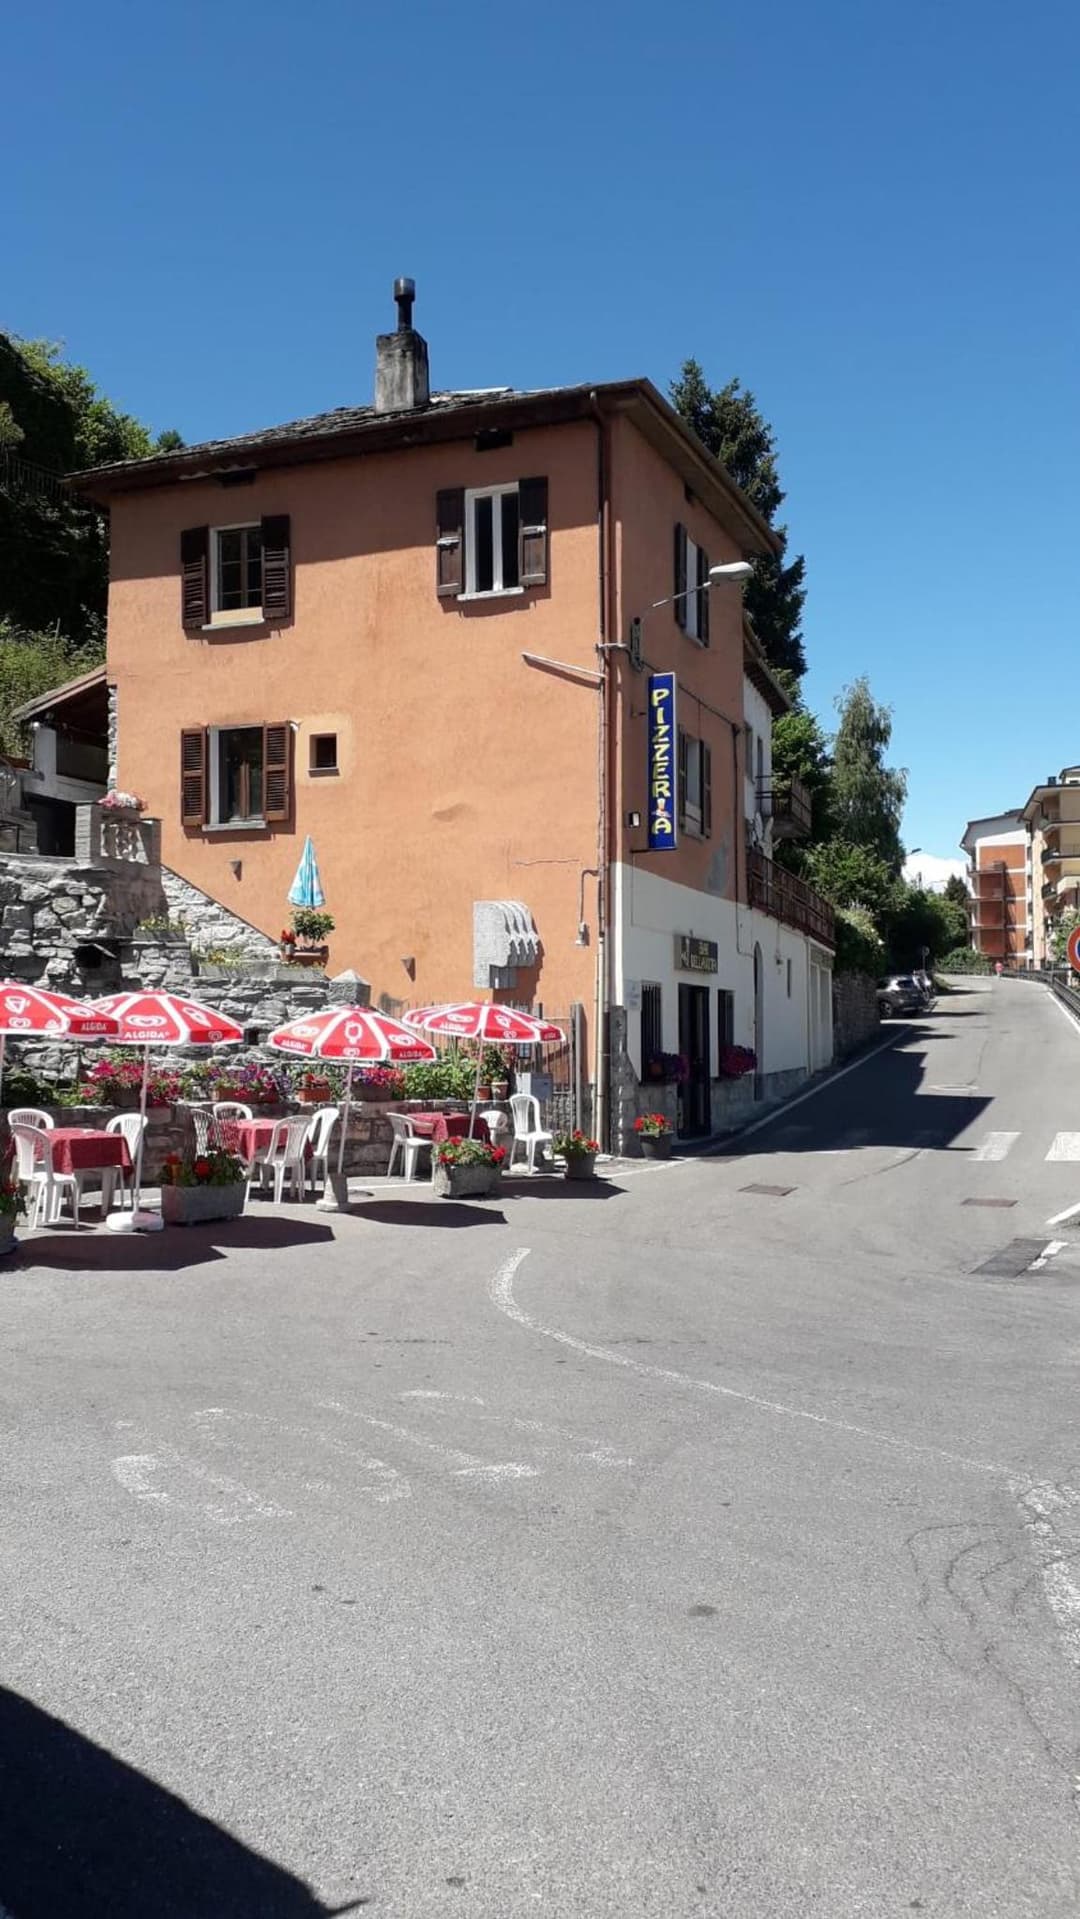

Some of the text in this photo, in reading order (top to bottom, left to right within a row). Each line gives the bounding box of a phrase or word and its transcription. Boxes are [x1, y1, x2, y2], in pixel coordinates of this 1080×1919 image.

[651, 688, 672, 834] PIZZERIA
[81, 1022, 107, 1031] ALGIDA
[124, 1031, 165, 1039] ALGIDA
